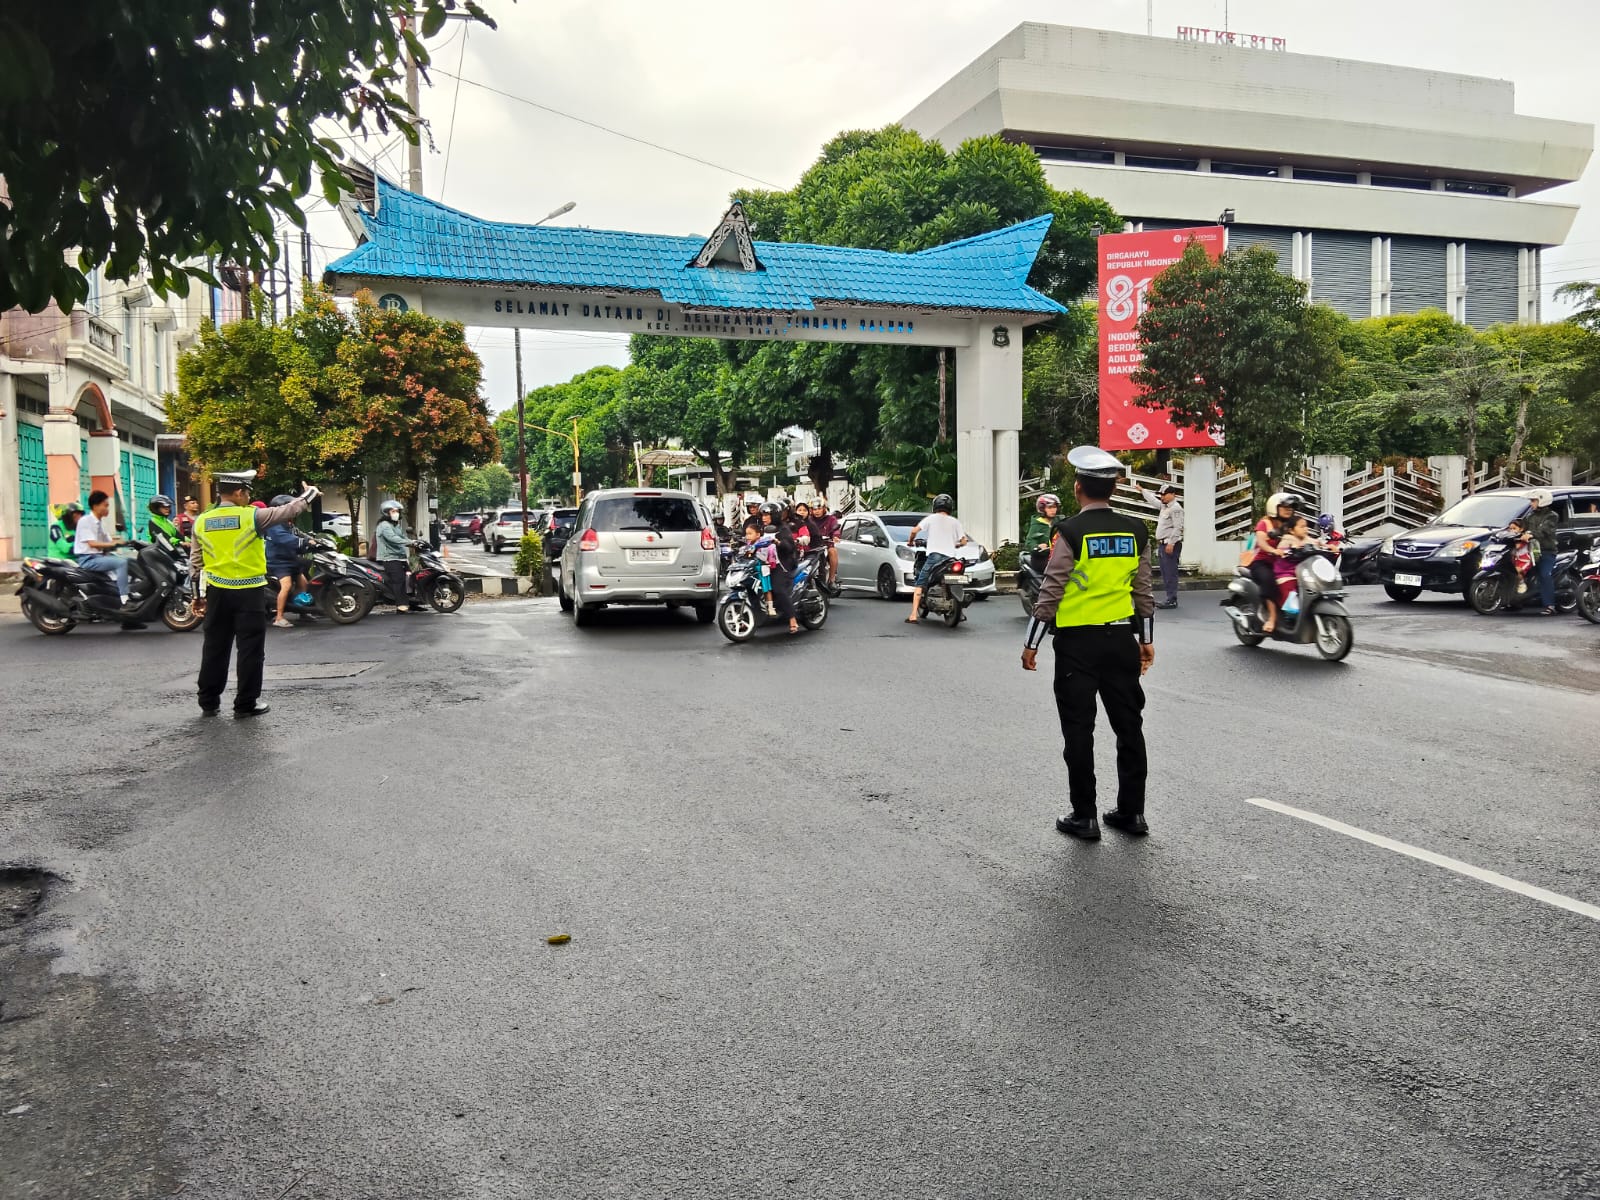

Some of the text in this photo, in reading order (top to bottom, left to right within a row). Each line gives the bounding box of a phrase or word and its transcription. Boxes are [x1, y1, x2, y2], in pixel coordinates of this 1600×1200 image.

[1177, 26, 1210, 42] HUT
[1272, 37, 1286, 53] RI
[1106, 250, 1149, 260] DIRGAHAYU
[1106, 258, 1181, 270] REPUBLIK INDONESI
[1106, 275, 1152, 324] 81
[494, 300, 569, 316] SELAMAT
[584, 304, 643, 320] DATANG
[657, 308, 671, 321] DI
[647, 323, 679, 331] KEC.
[1108, 331, 1140, 341] INDONE
[1108, 343, 1142, 352] BERDA
[1108, 354, 1127, 363] ADIL
[1108, 365, 1146, 374] MAKM
[205, 518, 239, 530] POLISI
[1086, 538, 1134, 556] POLISI
